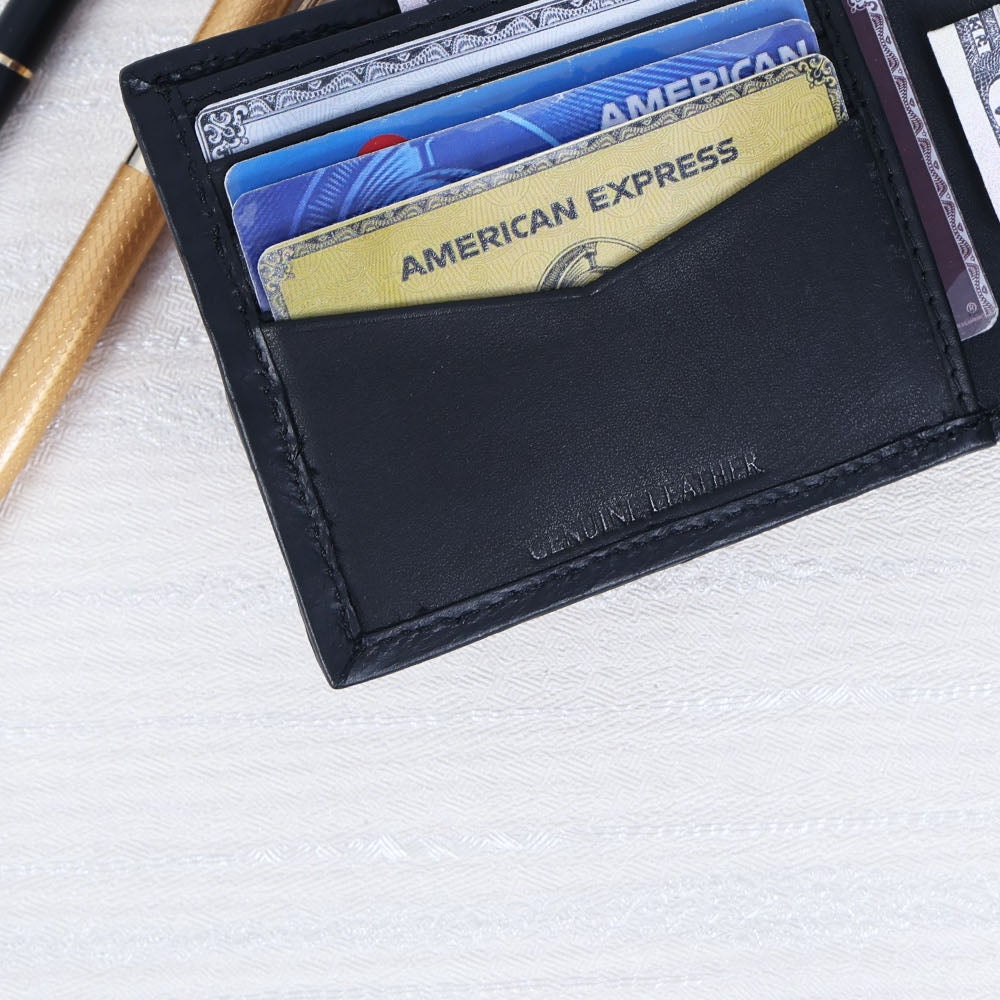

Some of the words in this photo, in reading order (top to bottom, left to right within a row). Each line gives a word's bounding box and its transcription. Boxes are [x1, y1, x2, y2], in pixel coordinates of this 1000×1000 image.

[401, 196, 579, 283] AMERICAN
[585, 136, 741, 214] EXPRESS
[647, 448, 765, 512] LEATHER
